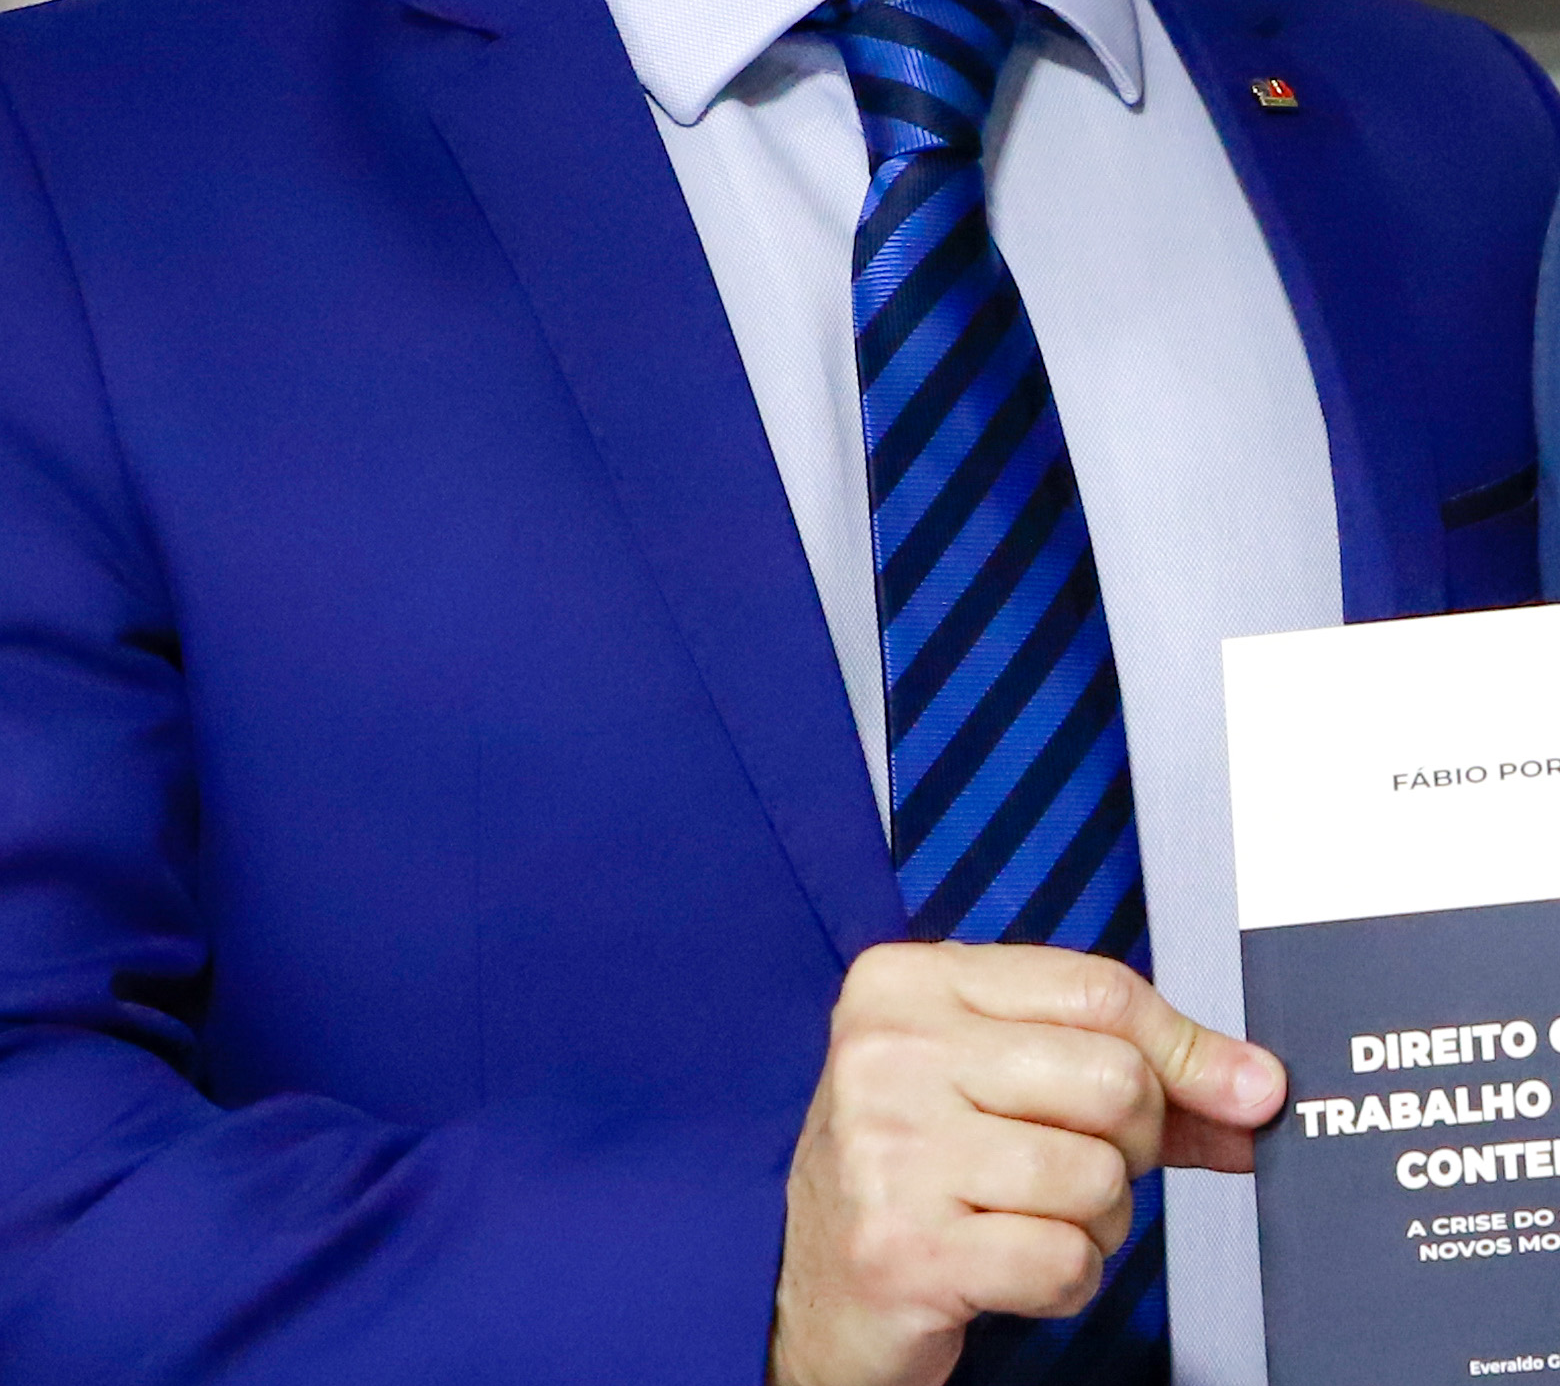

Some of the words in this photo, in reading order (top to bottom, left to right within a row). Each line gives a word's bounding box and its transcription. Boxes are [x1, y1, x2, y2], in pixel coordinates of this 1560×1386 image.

[1393, 767, 1488, 791] FÁBIO
[1351, 1020, 1538, 1074] DIREITO
[1296, 1079, 1552, 1138] TRABALHO
[1406, 1219, 1427, 1238] A
[1432, 1213, 1508, 1235] CRISE
[1514, 1208, 1555, 1229] DO
[1419, 1237, 1513, 1262] NOVOS
[1469, 1357, 1544, 1376] Everaldo
